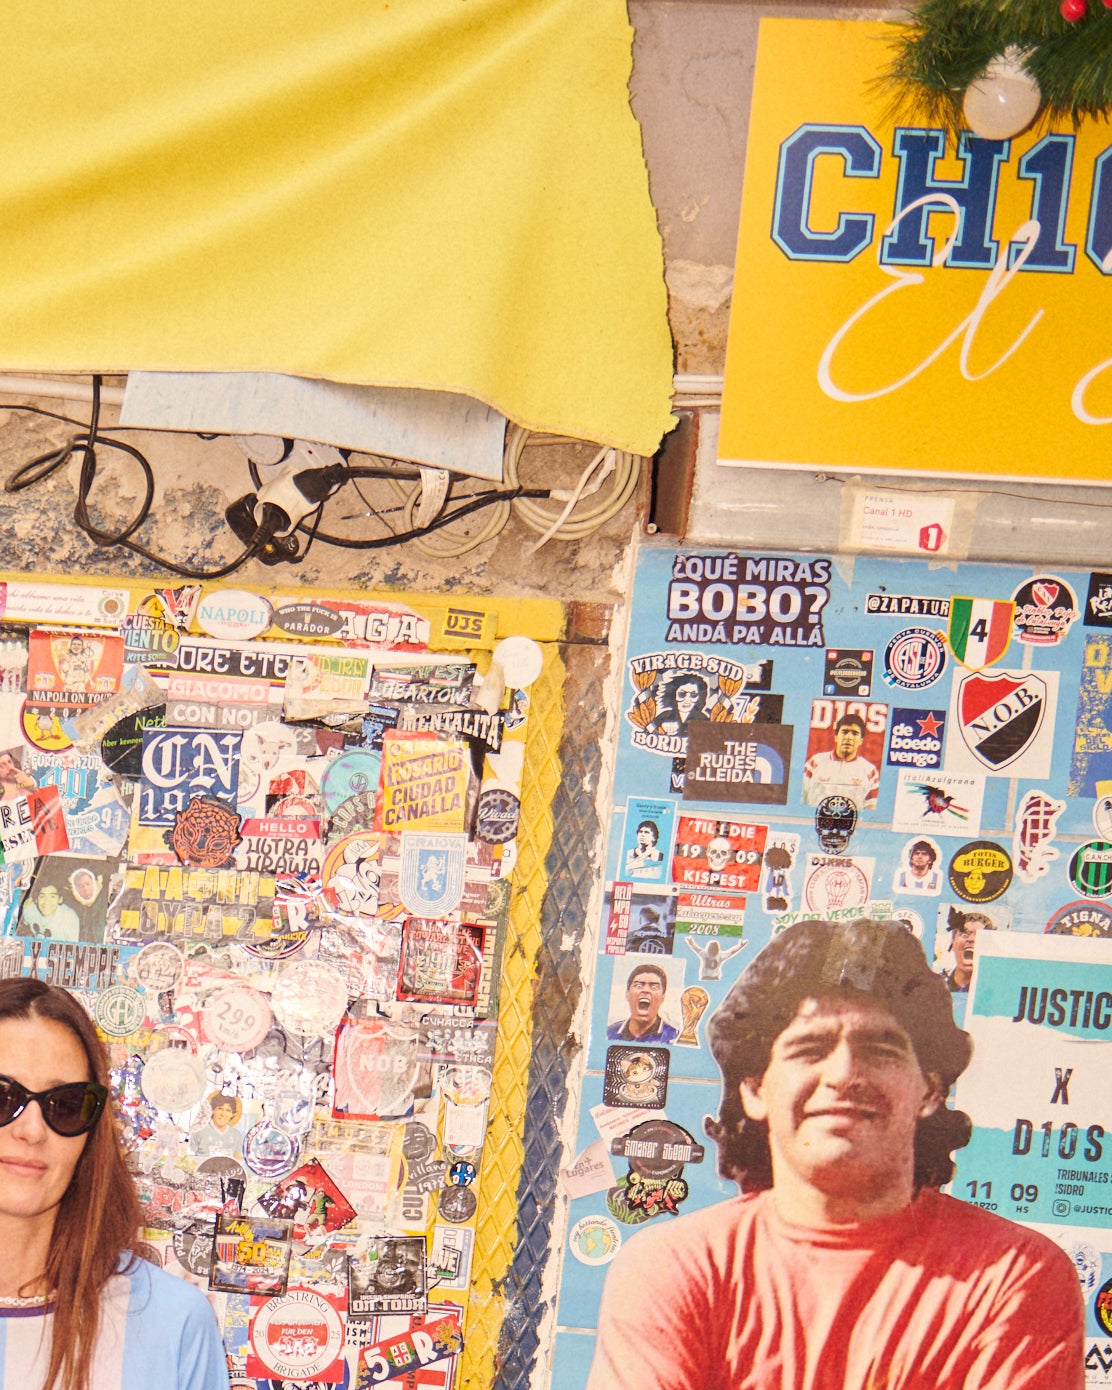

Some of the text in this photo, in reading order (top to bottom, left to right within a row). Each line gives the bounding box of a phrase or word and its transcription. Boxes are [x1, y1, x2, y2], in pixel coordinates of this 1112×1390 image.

[864, 506, 912, 518] Canal HD
[671, 556, 830, 584] ¿QUÉ MIRAS
[669, 582, 828, 622] BOBO?
[201, 605, 266, 626] NAPOLI
[447, 615, 482, 632] UJS
[284, 623, 330, 634] PARADOR
[665, 620, 824, 646] ANDÁ ALLÁ
[631, 654, 744, 682] VIRAGE SUD
[33, 690, 85, 703] NAPOLI ON
[172, 680, 267, 701] GIACOMO
[173, 706, 260, 726] CON NOI
[892, 723, 913, 736] de
[724, 741, 757, 755] THE
[890, 738, 941, 751] boedo
[700, 755, 756, 769] RUDES
[890, 751, 937, 766] vengo
[390, 752, 462, 785] ROSARIO
[696, 768, 754, 783] LLEIDA
[392, 776, 456, 807] CIUDAD
[384, 795, 462, 827] CANALLA
[259, 823, 307, 834] HELLO
[729, 826, 756, 839] DIE
[681, 844, 758, 864] 19 09
[963, 858, 1005, 869] BURGER
[684, 871, 746, 888] KISPEST
[689, 895, 731, 909] Ultras
[688, 923, 720, 935] 2008
[217, 999, 256, 1032] 299
[359, 1054, 409, 1074] NOB
[1057, 1168, 1108, 1183] TRIBUNALES
[967, 1181, 1038, 1202] 11 09
[352, 1300, 424, 1312] ON TOUR
[364, 1331, 437, 1380] 5 R
